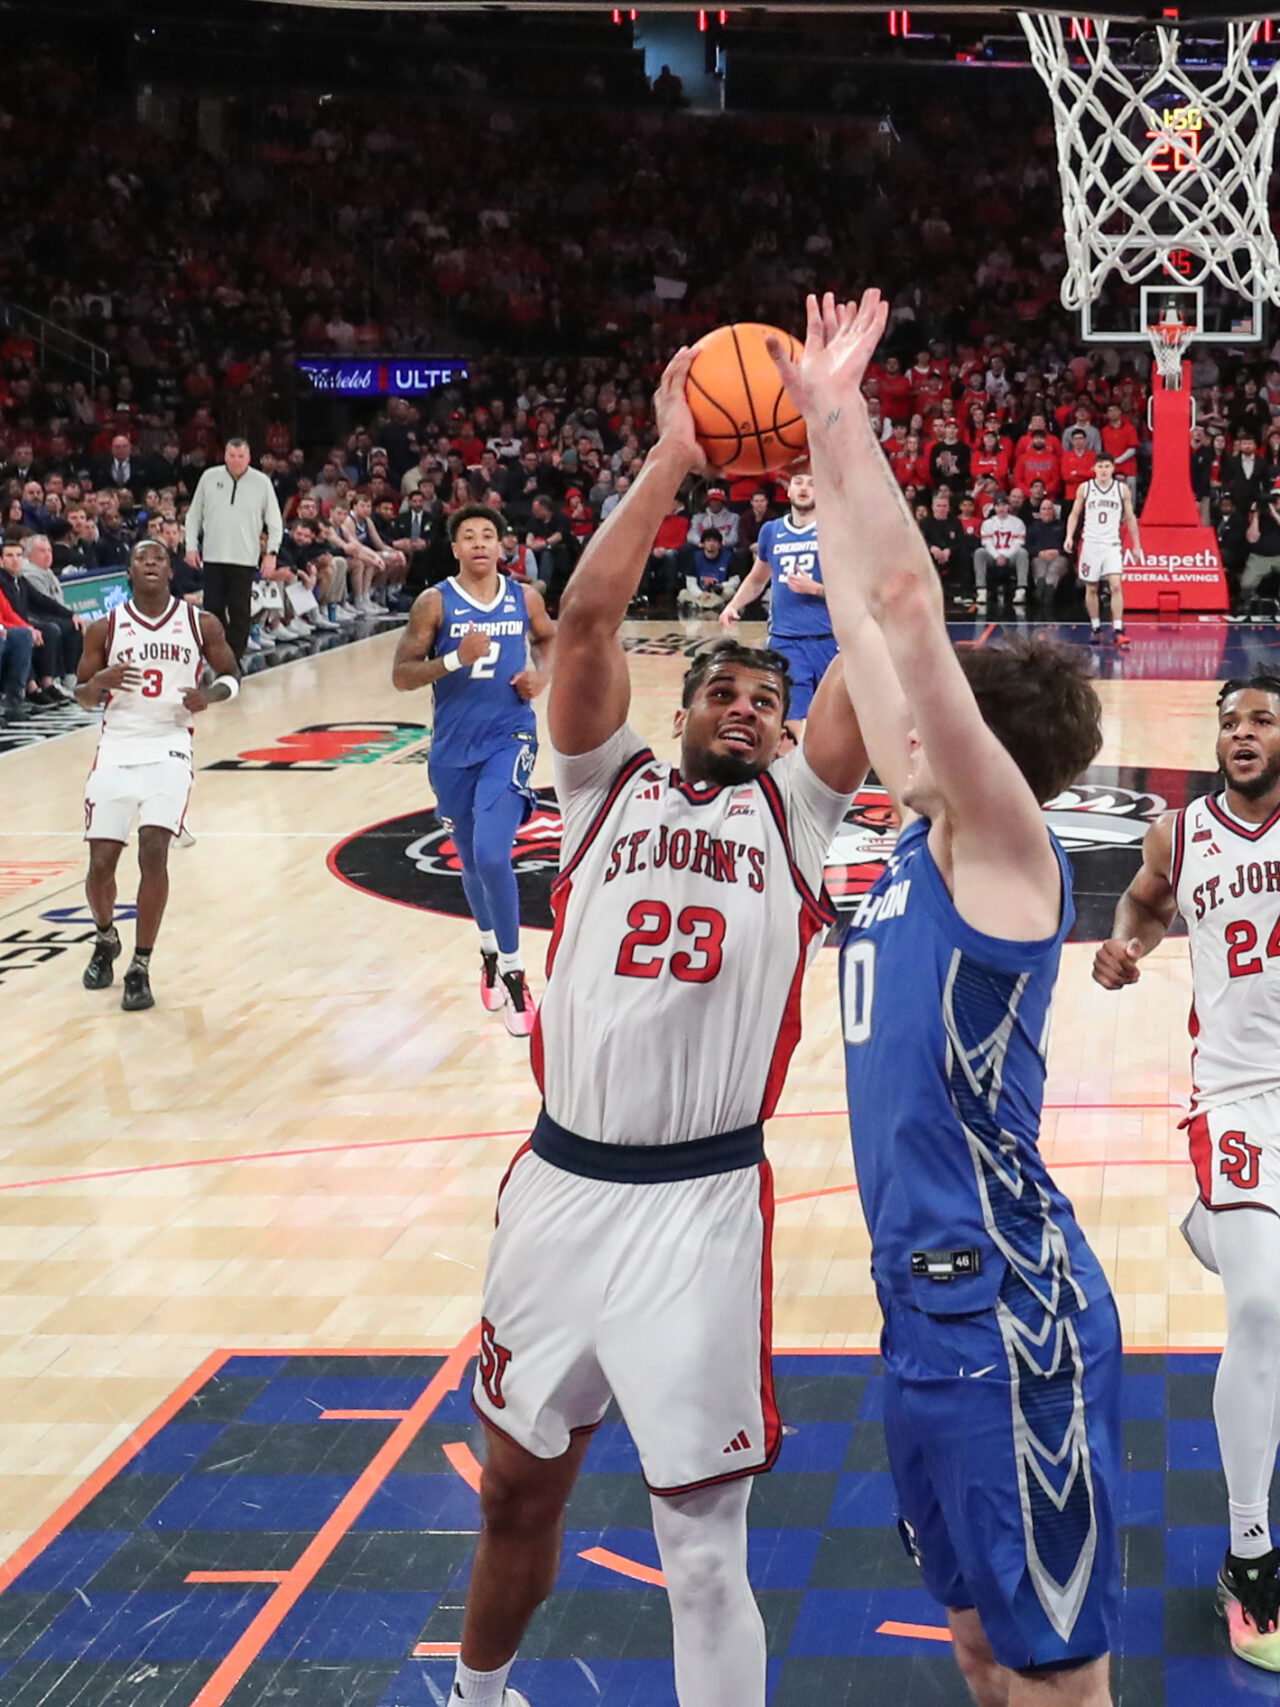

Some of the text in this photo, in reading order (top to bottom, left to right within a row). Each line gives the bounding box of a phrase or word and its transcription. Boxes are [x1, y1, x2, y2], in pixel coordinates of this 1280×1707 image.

[1098, 511, 1108, 524] 0
[994, 531, 1012, 549] 17
[778, 553, 815, 583] 32
[1123, 549, 1218, 573] Maspeth
[1121, 574, 1219, 582] FEDERAL SAVINGS
[139, 643, 191, 664] JOHN'S
[470, 641, 501, 679] 2
[141, 669, 163, 698] 3
[1196, 812, 1204, 828] C
[603, 825, 765, 893] ST. JOHN'S
[1193, 875, 1224, 922] ST.
[615, 900, 726, 984] 23
[844, 938, 877, 1044] 0
[955, 1255, 970, 1268] 46
